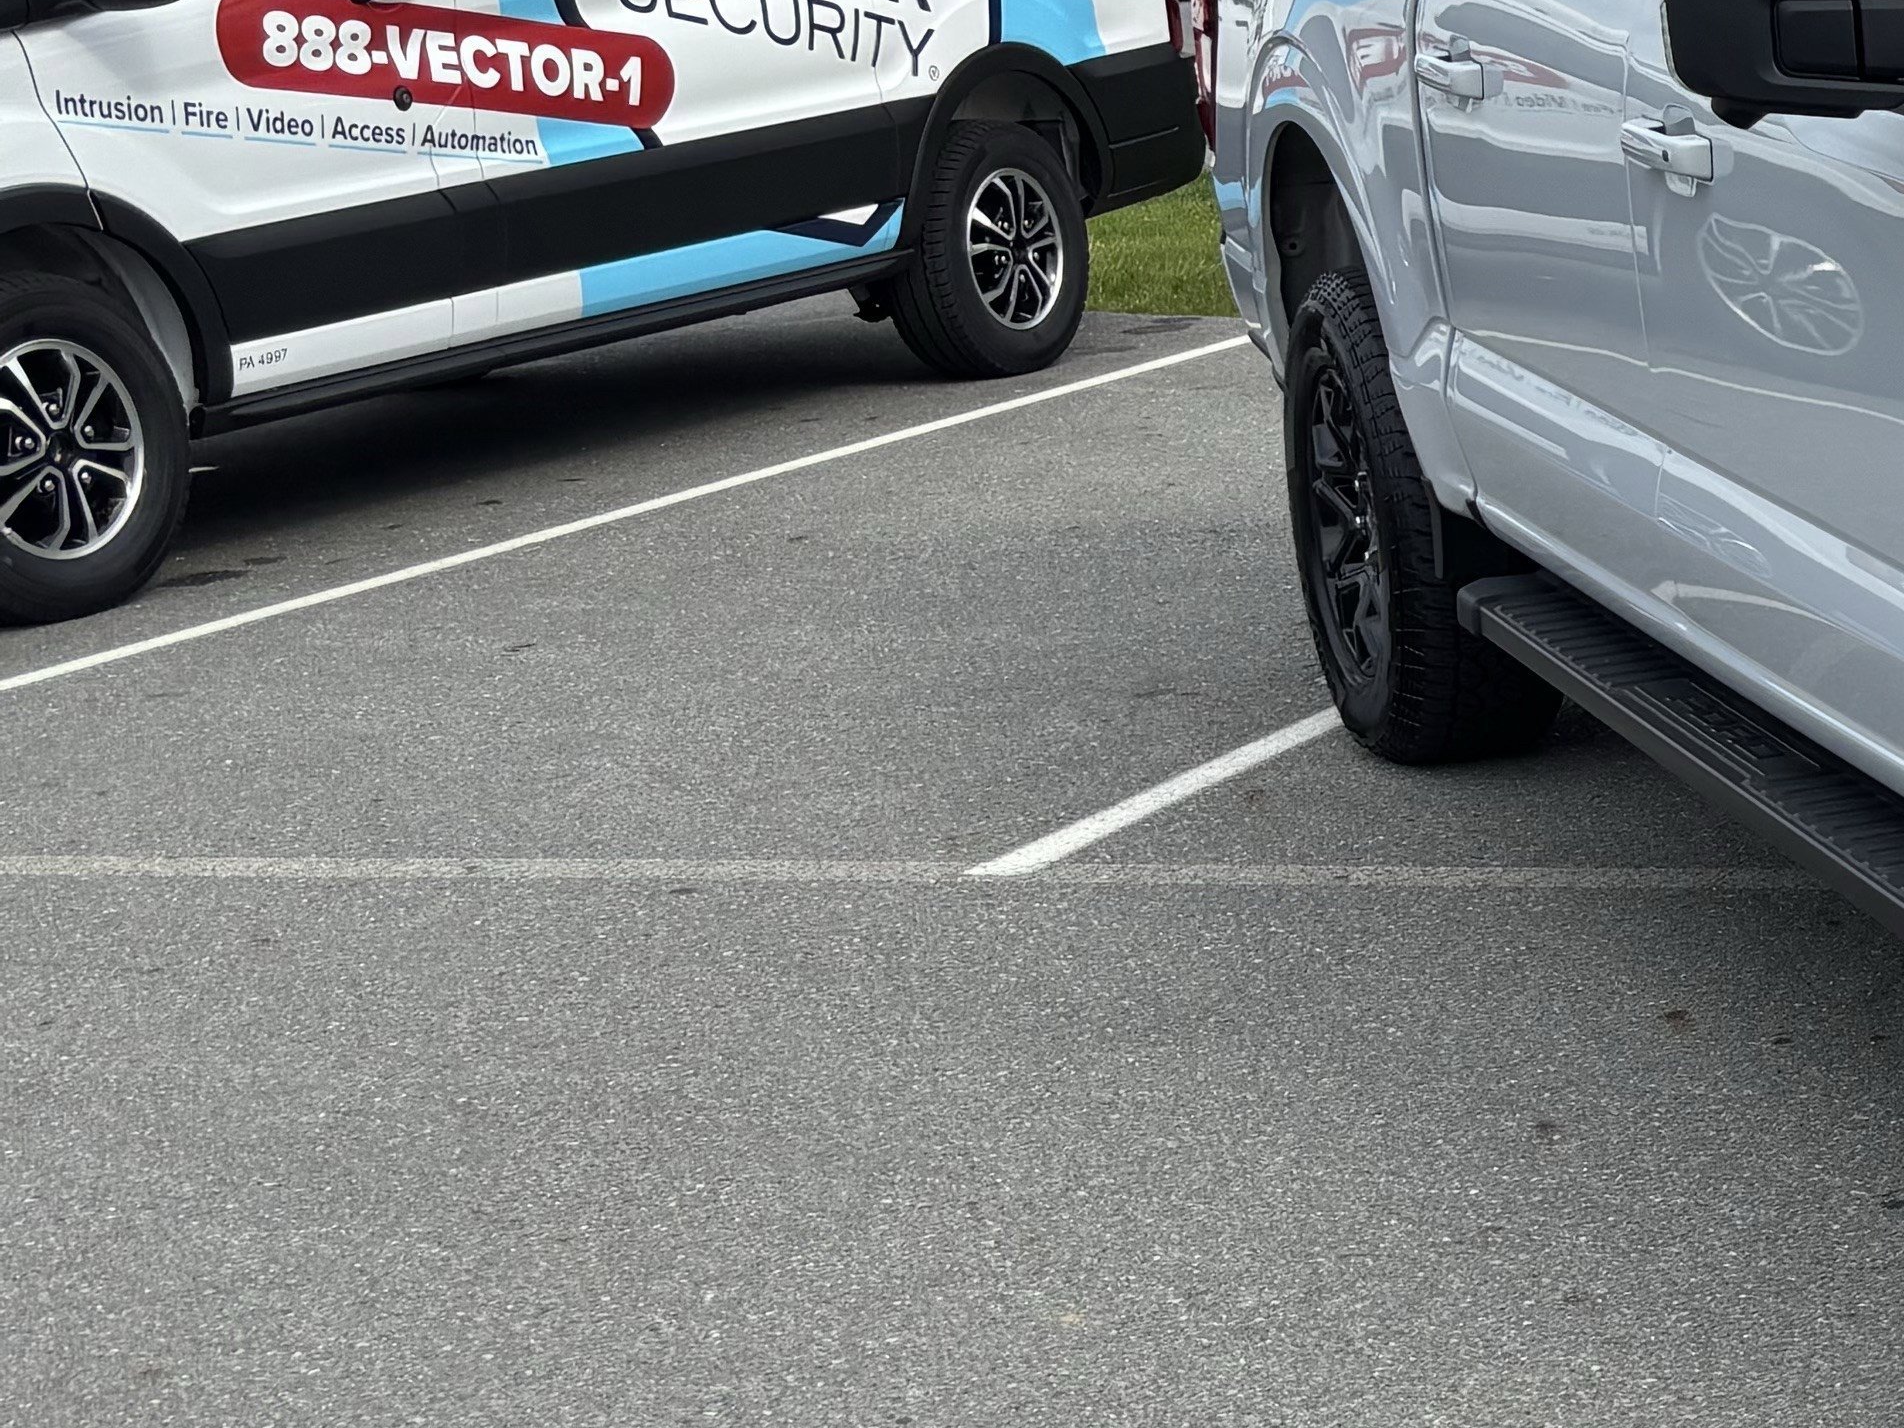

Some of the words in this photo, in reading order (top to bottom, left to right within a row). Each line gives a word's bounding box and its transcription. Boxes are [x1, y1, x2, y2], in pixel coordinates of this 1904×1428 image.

[262, 10, 642, 105] 888-VECTOR-1
[55, 90, 164, 124] Intrusion
[184, 102, 229, 130] Fire
[247, 108, 315, 137] Video
[332, 117, 406, 146] Access
[421, 124, 539, 157] Automation
[239, 355, 255, 371] PA
[258, 347, 288, 366] 4997
